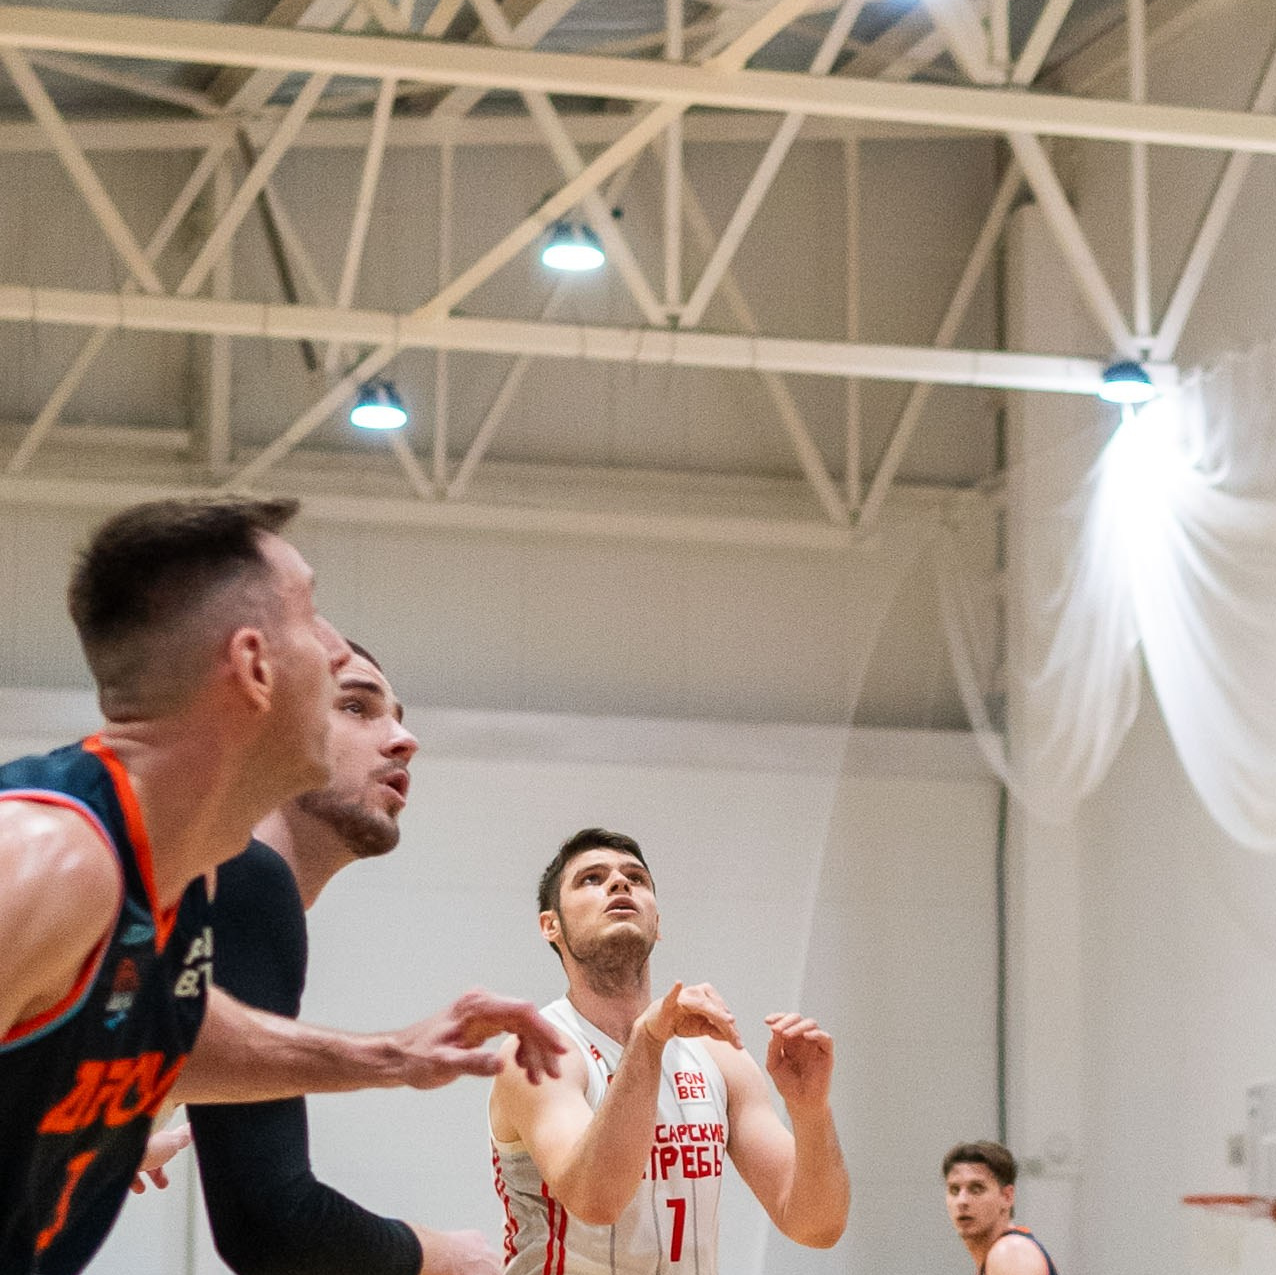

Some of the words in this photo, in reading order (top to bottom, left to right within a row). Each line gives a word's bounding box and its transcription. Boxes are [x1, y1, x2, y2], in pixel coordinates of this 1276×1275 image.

[674, 1072, 705, 1086] FON
[677, 1085, 707, 1100] BET
[655, 1124, 726, 1144] САРСКИЕ
